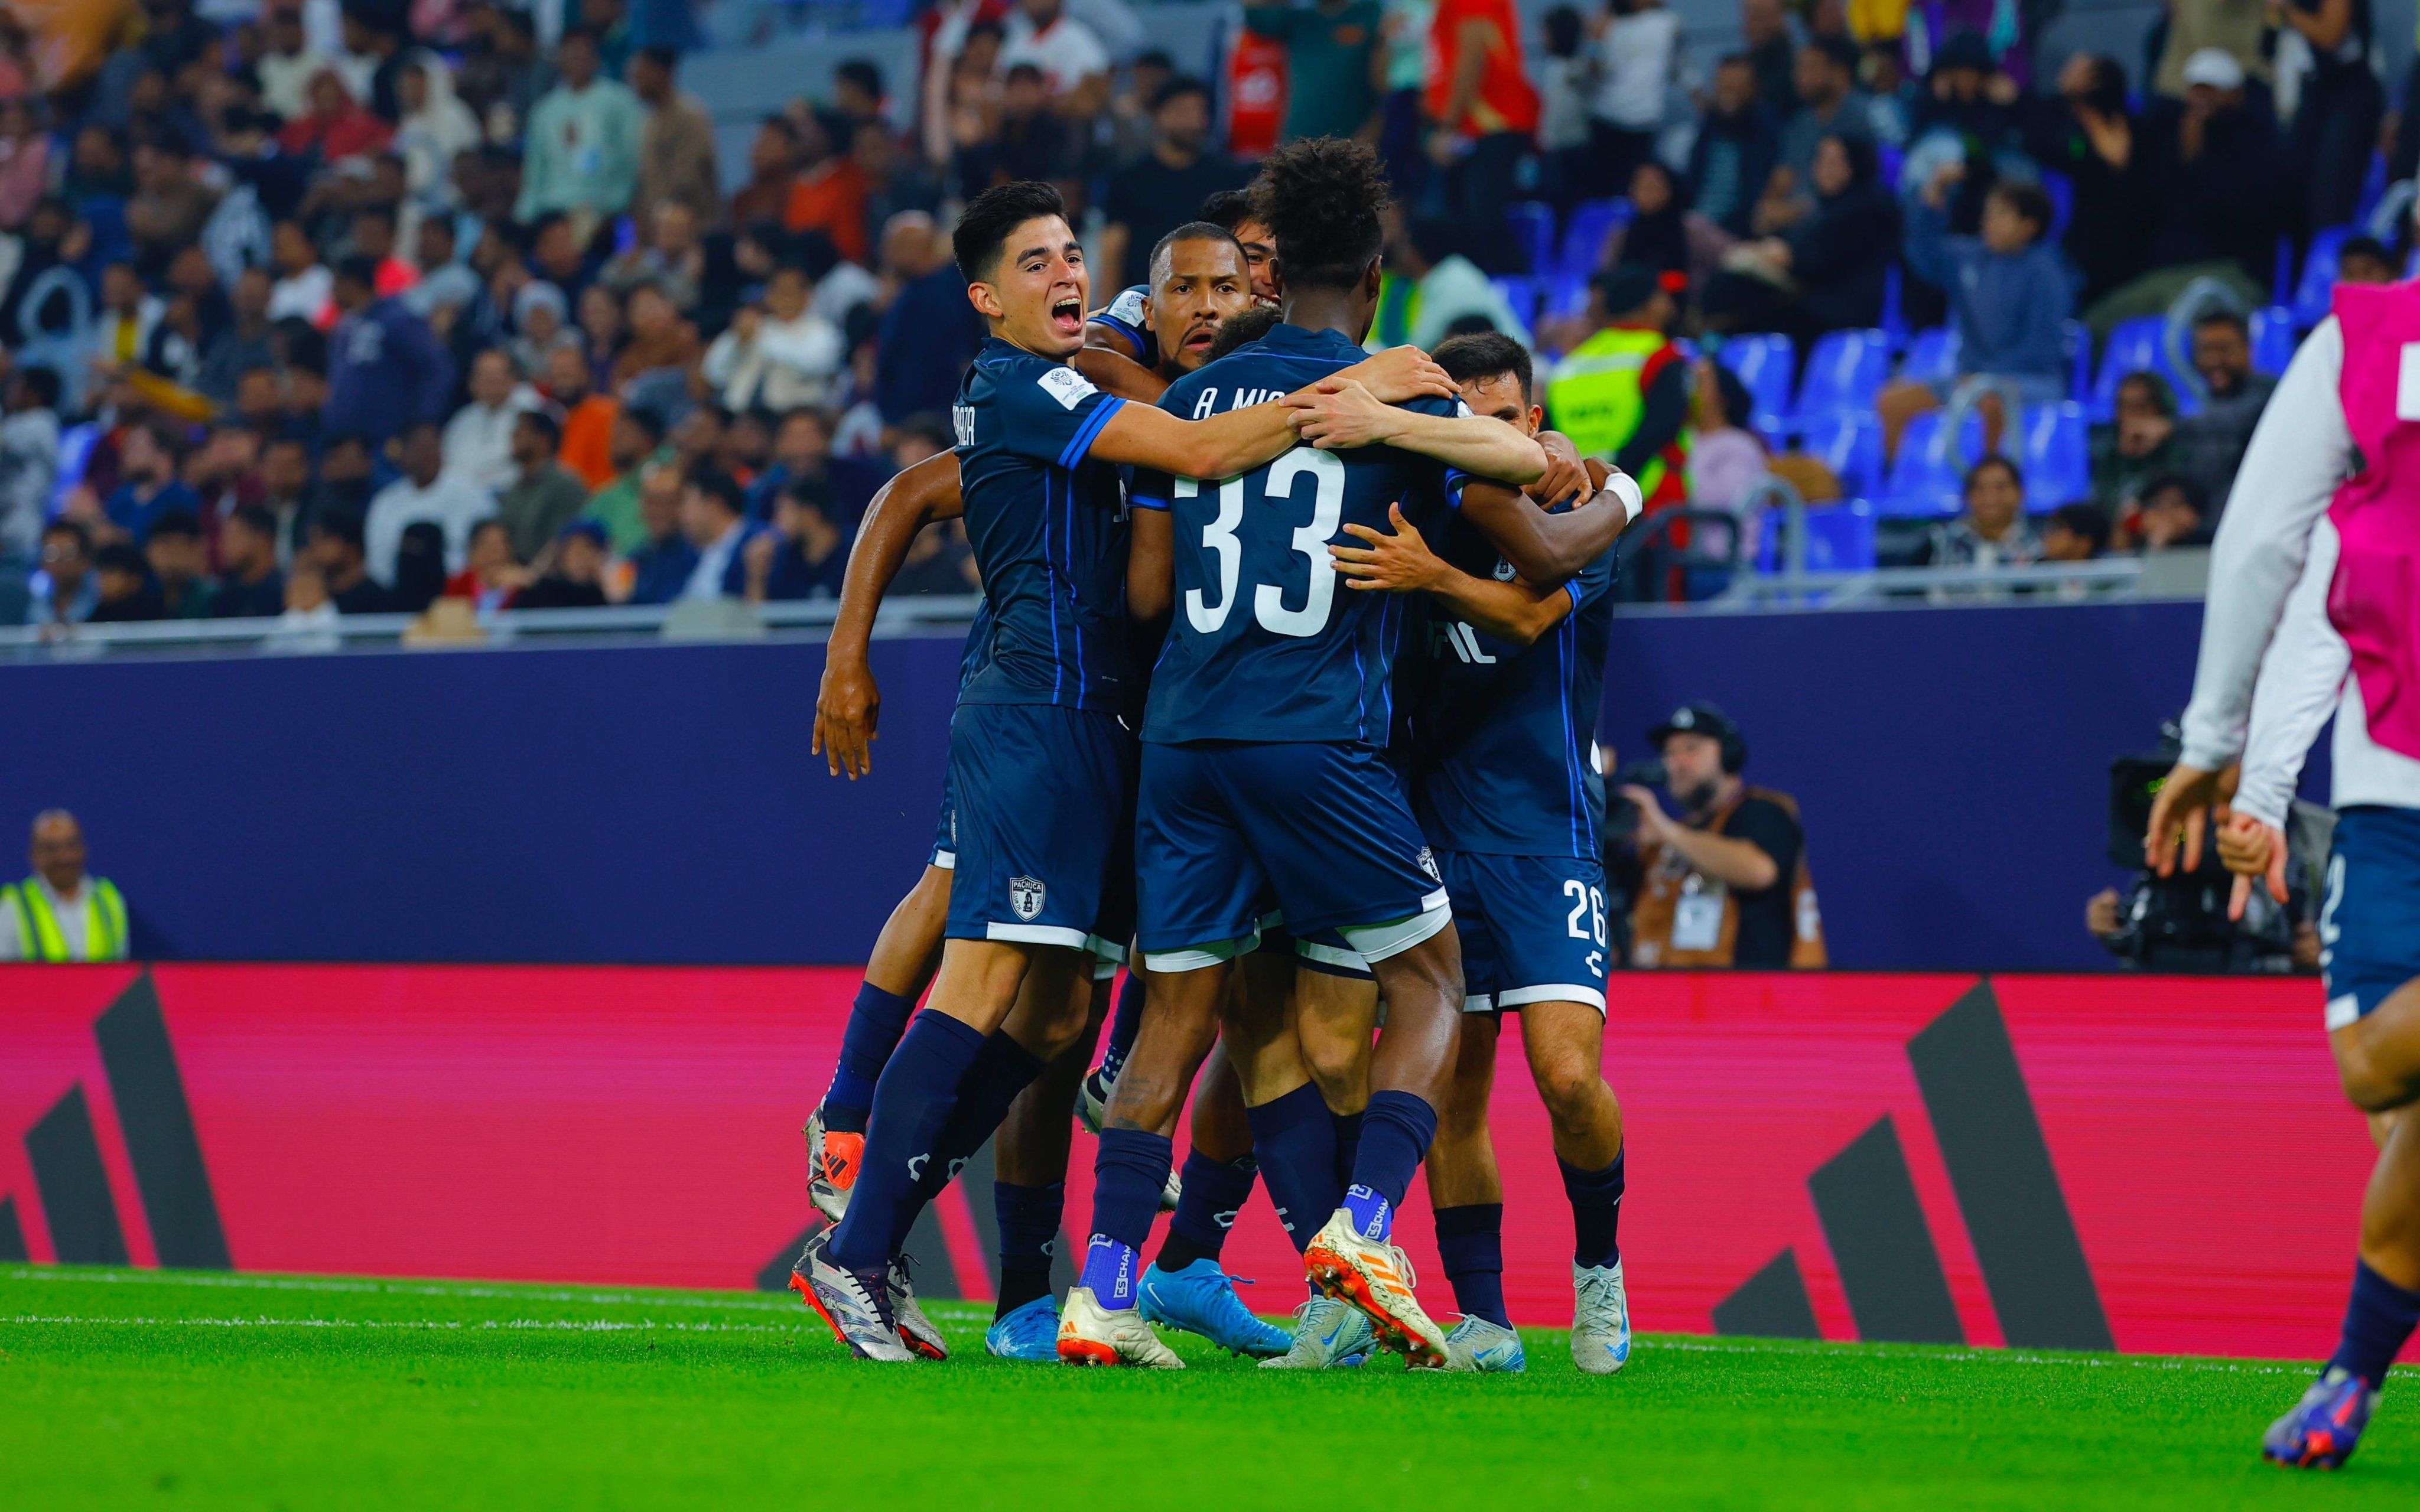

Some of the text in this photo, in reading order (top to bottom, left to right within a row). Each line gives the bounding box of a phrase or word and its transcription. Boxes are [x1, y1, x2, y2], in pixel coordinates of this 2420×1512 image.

[1174, 447, 1346, 637] 33
[1013, 880, 1042, 890] PACHUCA
[1563, 879, 1606, 948] 26
